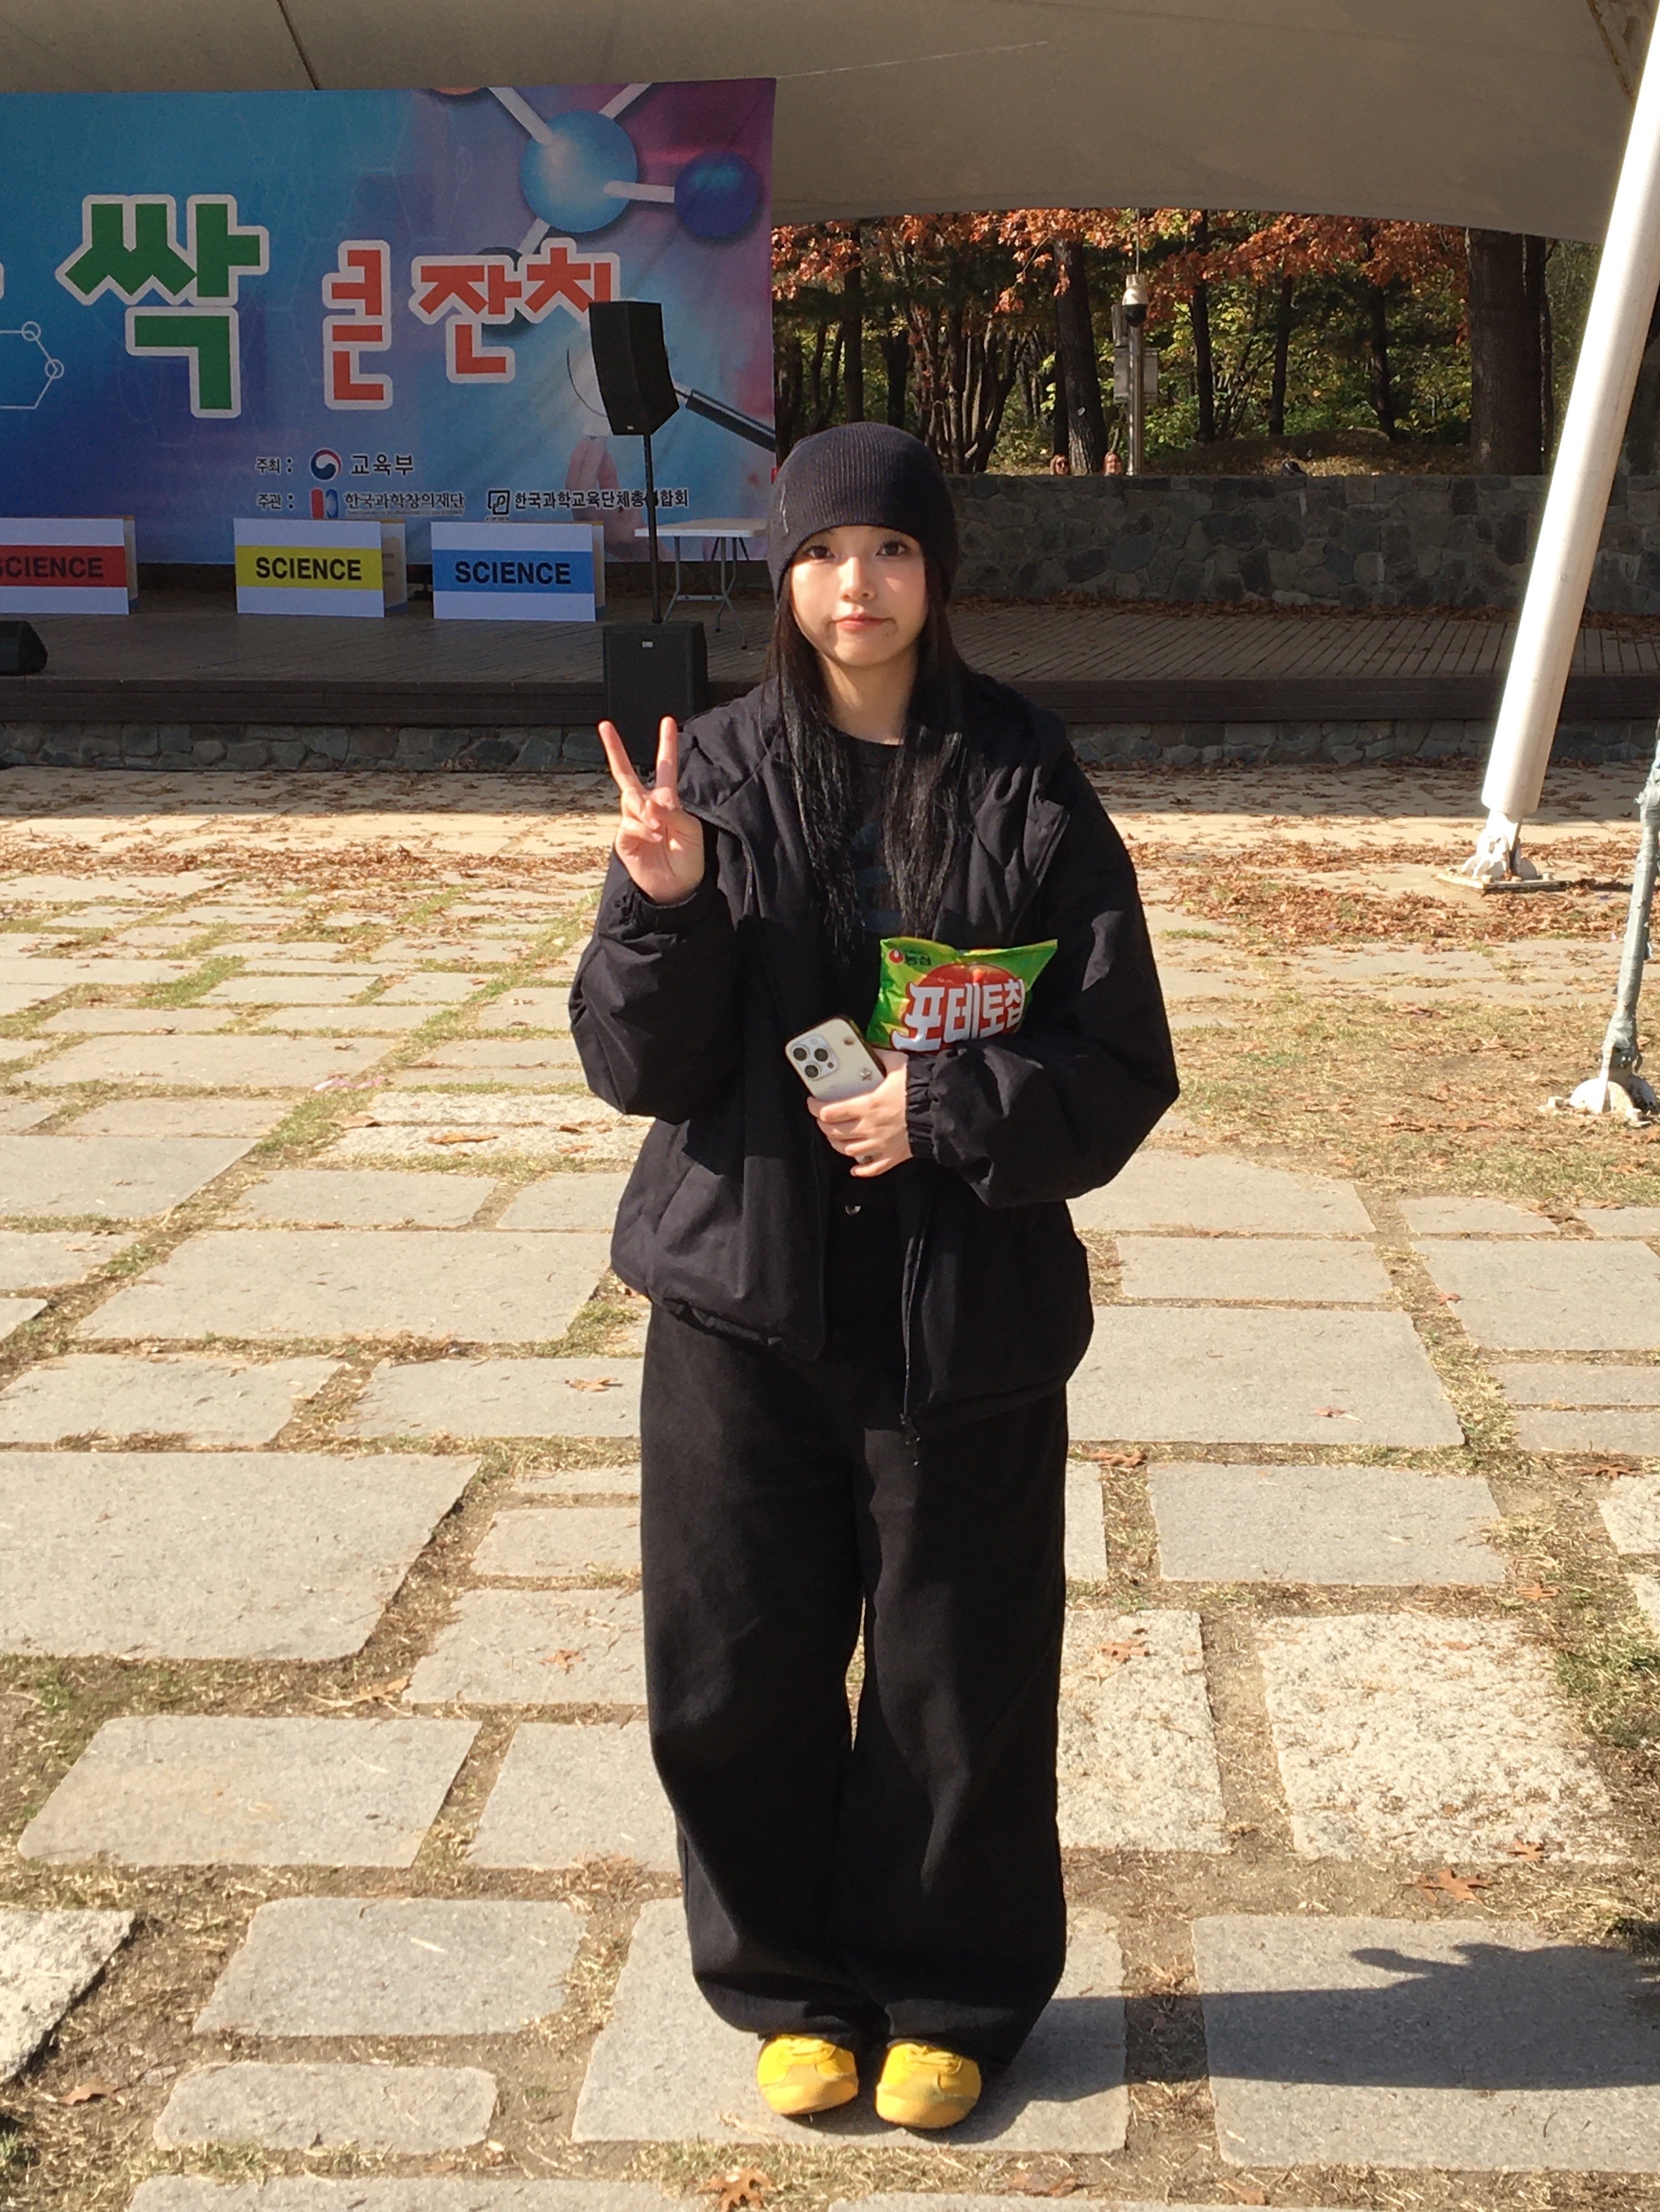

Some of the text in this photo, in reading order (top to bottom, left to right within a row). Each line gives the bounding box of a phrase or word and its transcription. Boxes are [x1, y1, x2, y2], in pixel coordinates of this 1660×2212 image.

[60, 199, 616, 414] 싹 큰 잔치
[257, 458, 281, 474] 주최
[351, 455, 413, 476] 교육부
[258, 494, 282, 509] 주관
[345, 493, 465, 509] 한국과학창의재단
[515, 489, 688, 509] 한국과학교육단체총합회
[0, 556, 104, 578] CIENCE
[256, 557, 361, 581] SCIENCE
[455, 561, 571, 585] SCIENCE
[891, 979, 1026, 1051] 포테토칩
